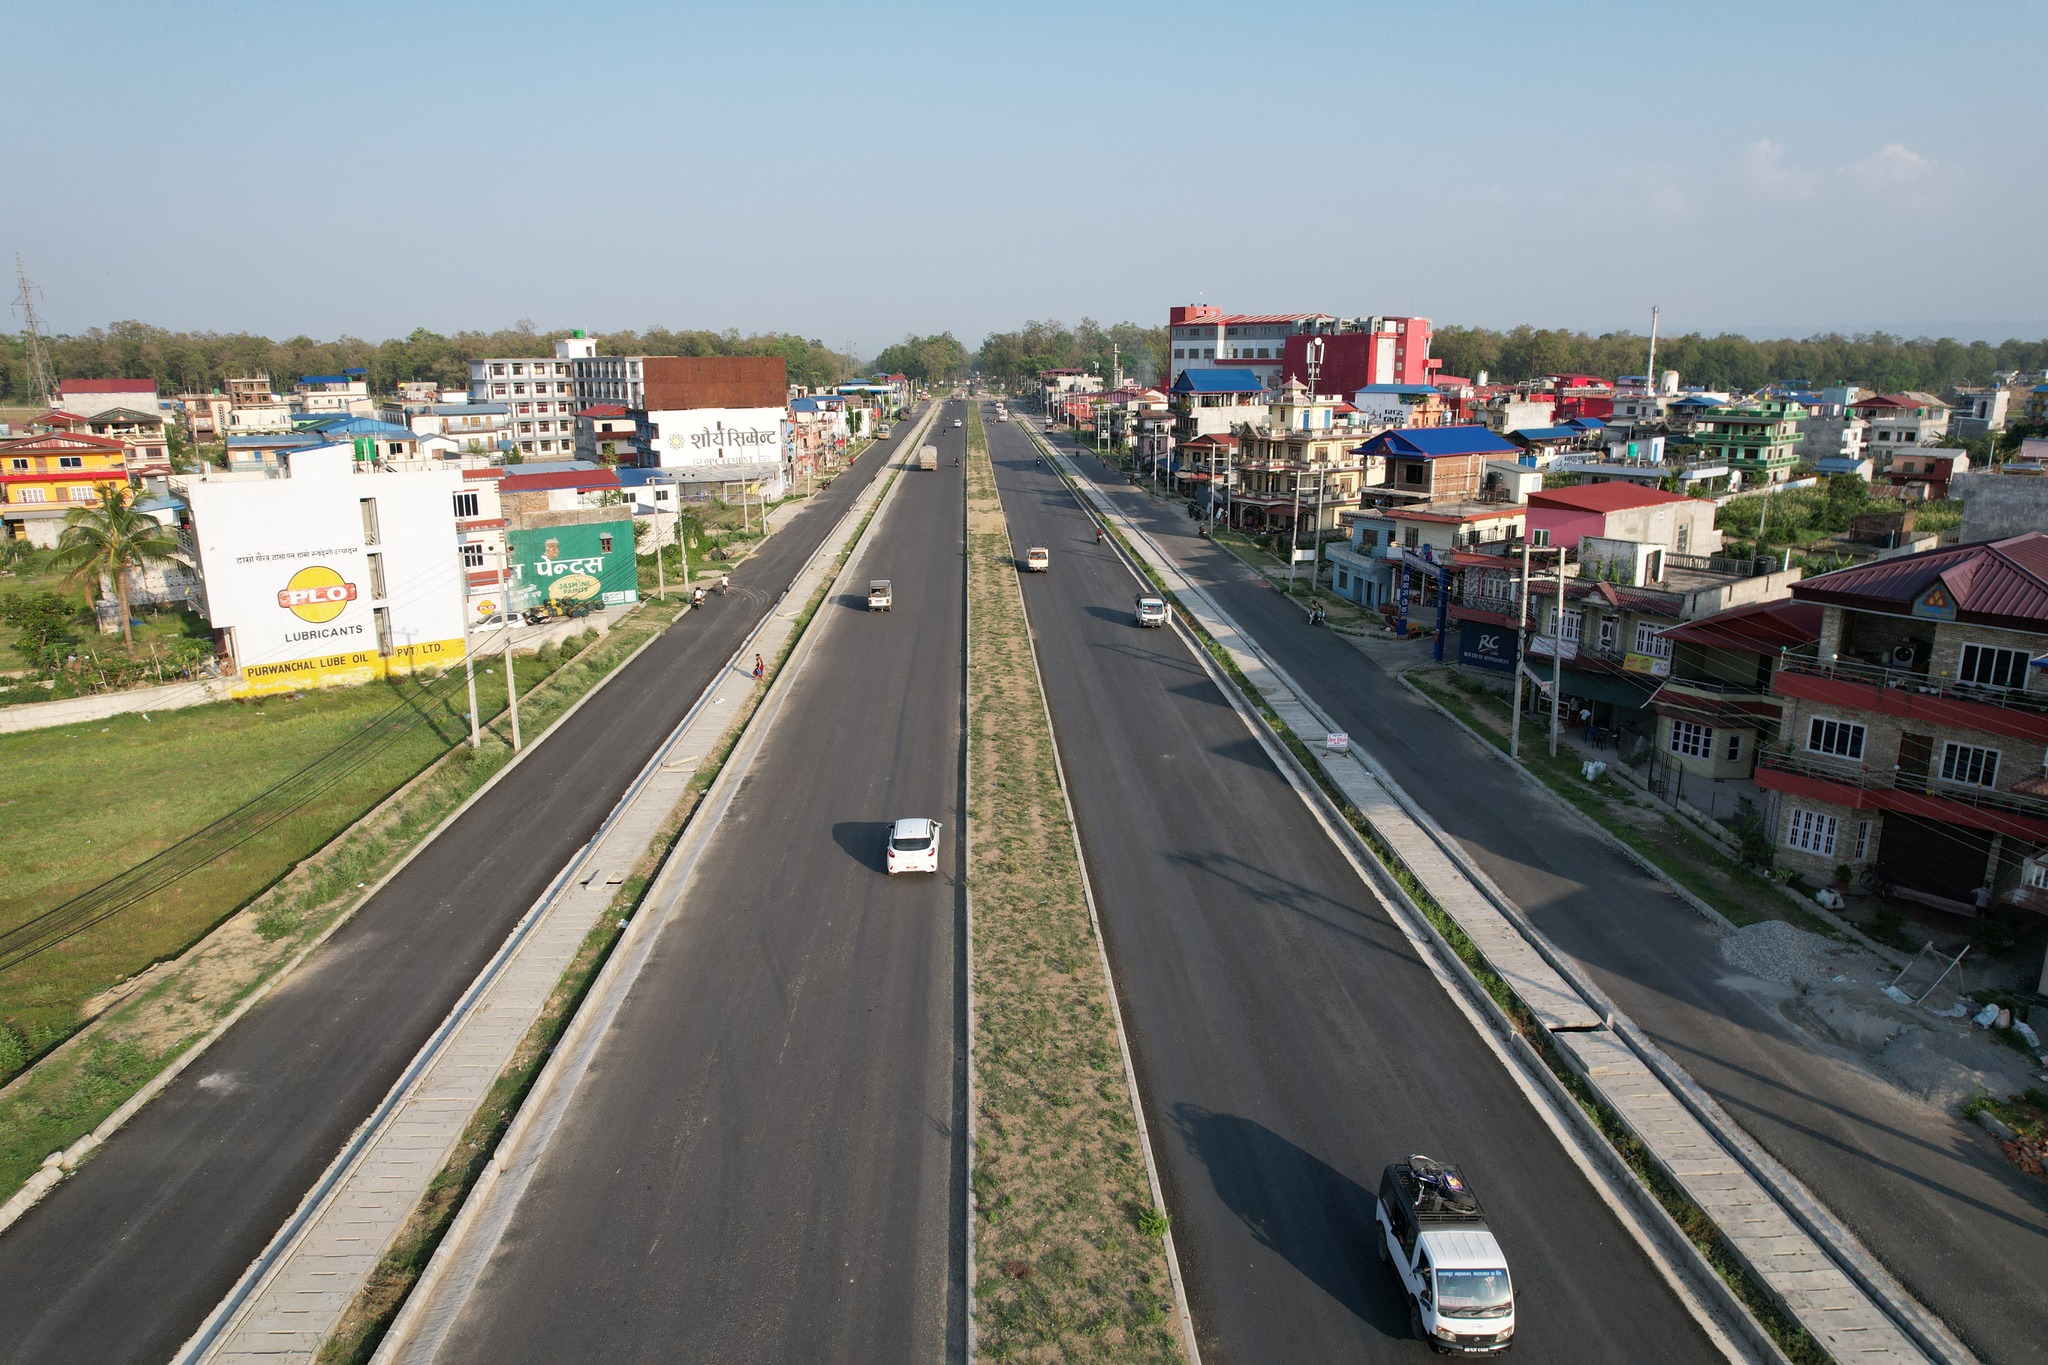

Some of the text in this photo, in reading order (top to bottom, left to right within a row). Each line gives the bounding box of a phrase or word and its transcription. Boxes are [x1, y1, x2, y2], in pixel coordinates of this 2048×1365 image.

[690, 426, 776, 449] शौर्य सिमेन्ट
[723, 456, 753, 465] CEMENT
[289, 586, 347, 605] PLO
[563, 587, 589, 595] PAINTS
[285, 625, 363, 643] LUBRICANTS
[1478, 634, 1499, 650] RC
[247, 643, 445, 678] PURWANCHAL LUBE OIL (PVT) LTD.
